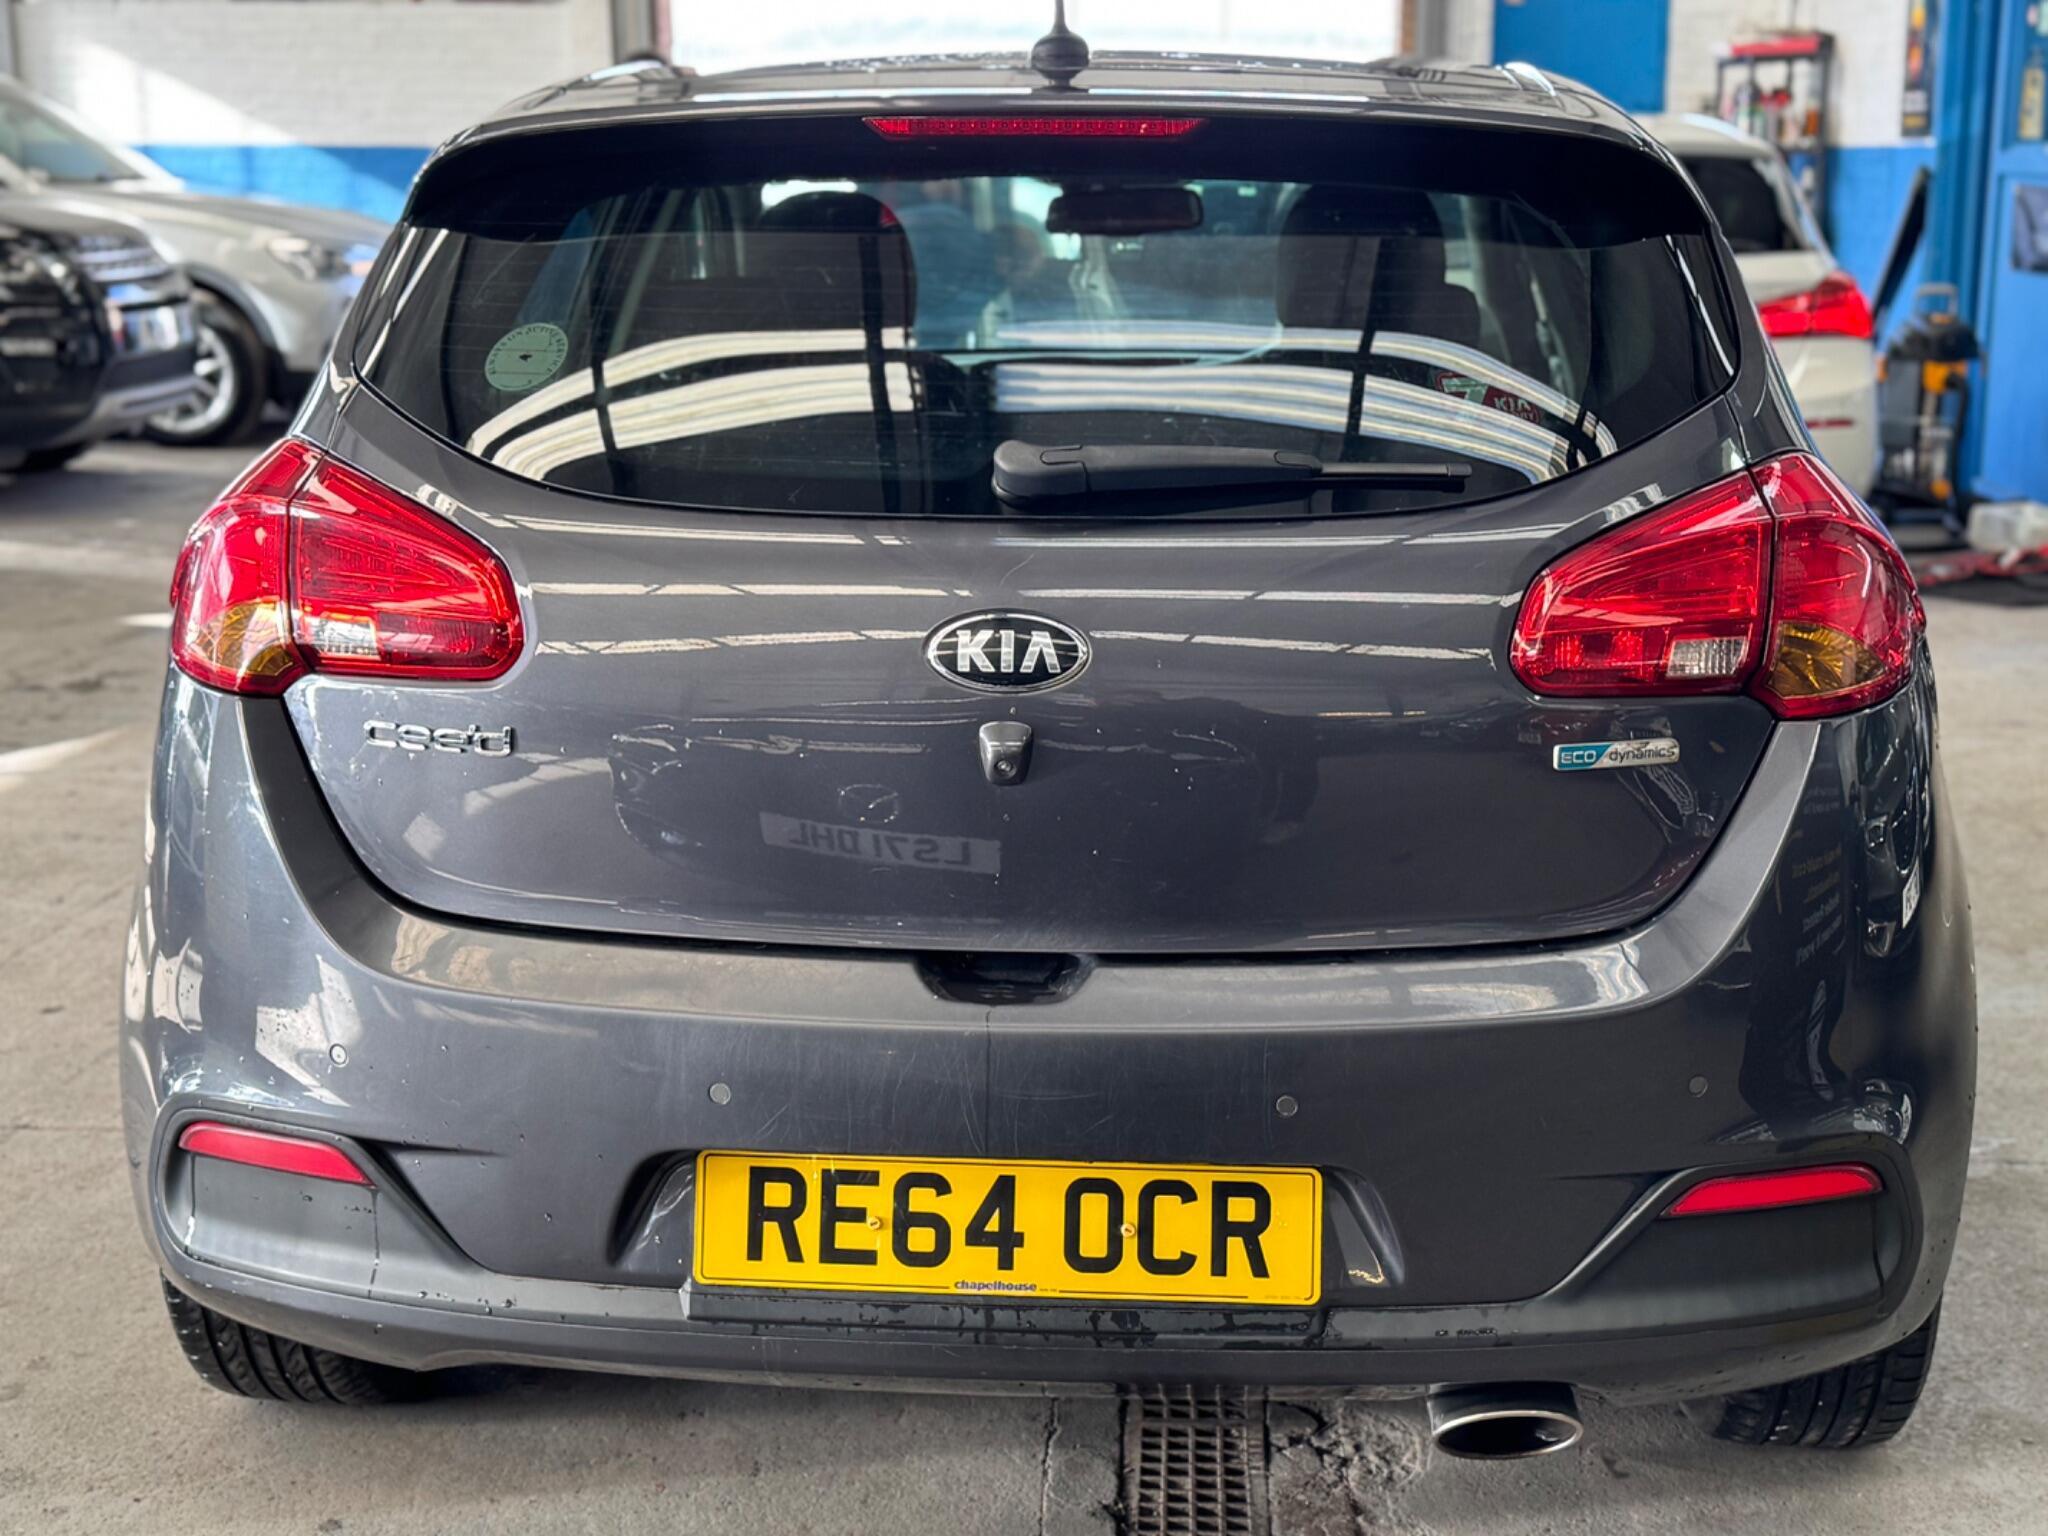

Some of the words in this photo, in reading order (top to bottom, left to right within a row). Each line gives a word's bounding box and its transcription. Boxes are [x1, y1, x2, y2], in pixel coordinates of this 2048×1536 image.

[956, 629, 1061, 673] KIA
[1561, 750, 1597, 764] ECO
[1608, 744, 1677, 763] dynamics
[746, 1165, 1025, 1271] RE64
[1063, 1176, 1272, 1279] OCR
[954, 1280, 1037, 1292] chapelhouse
